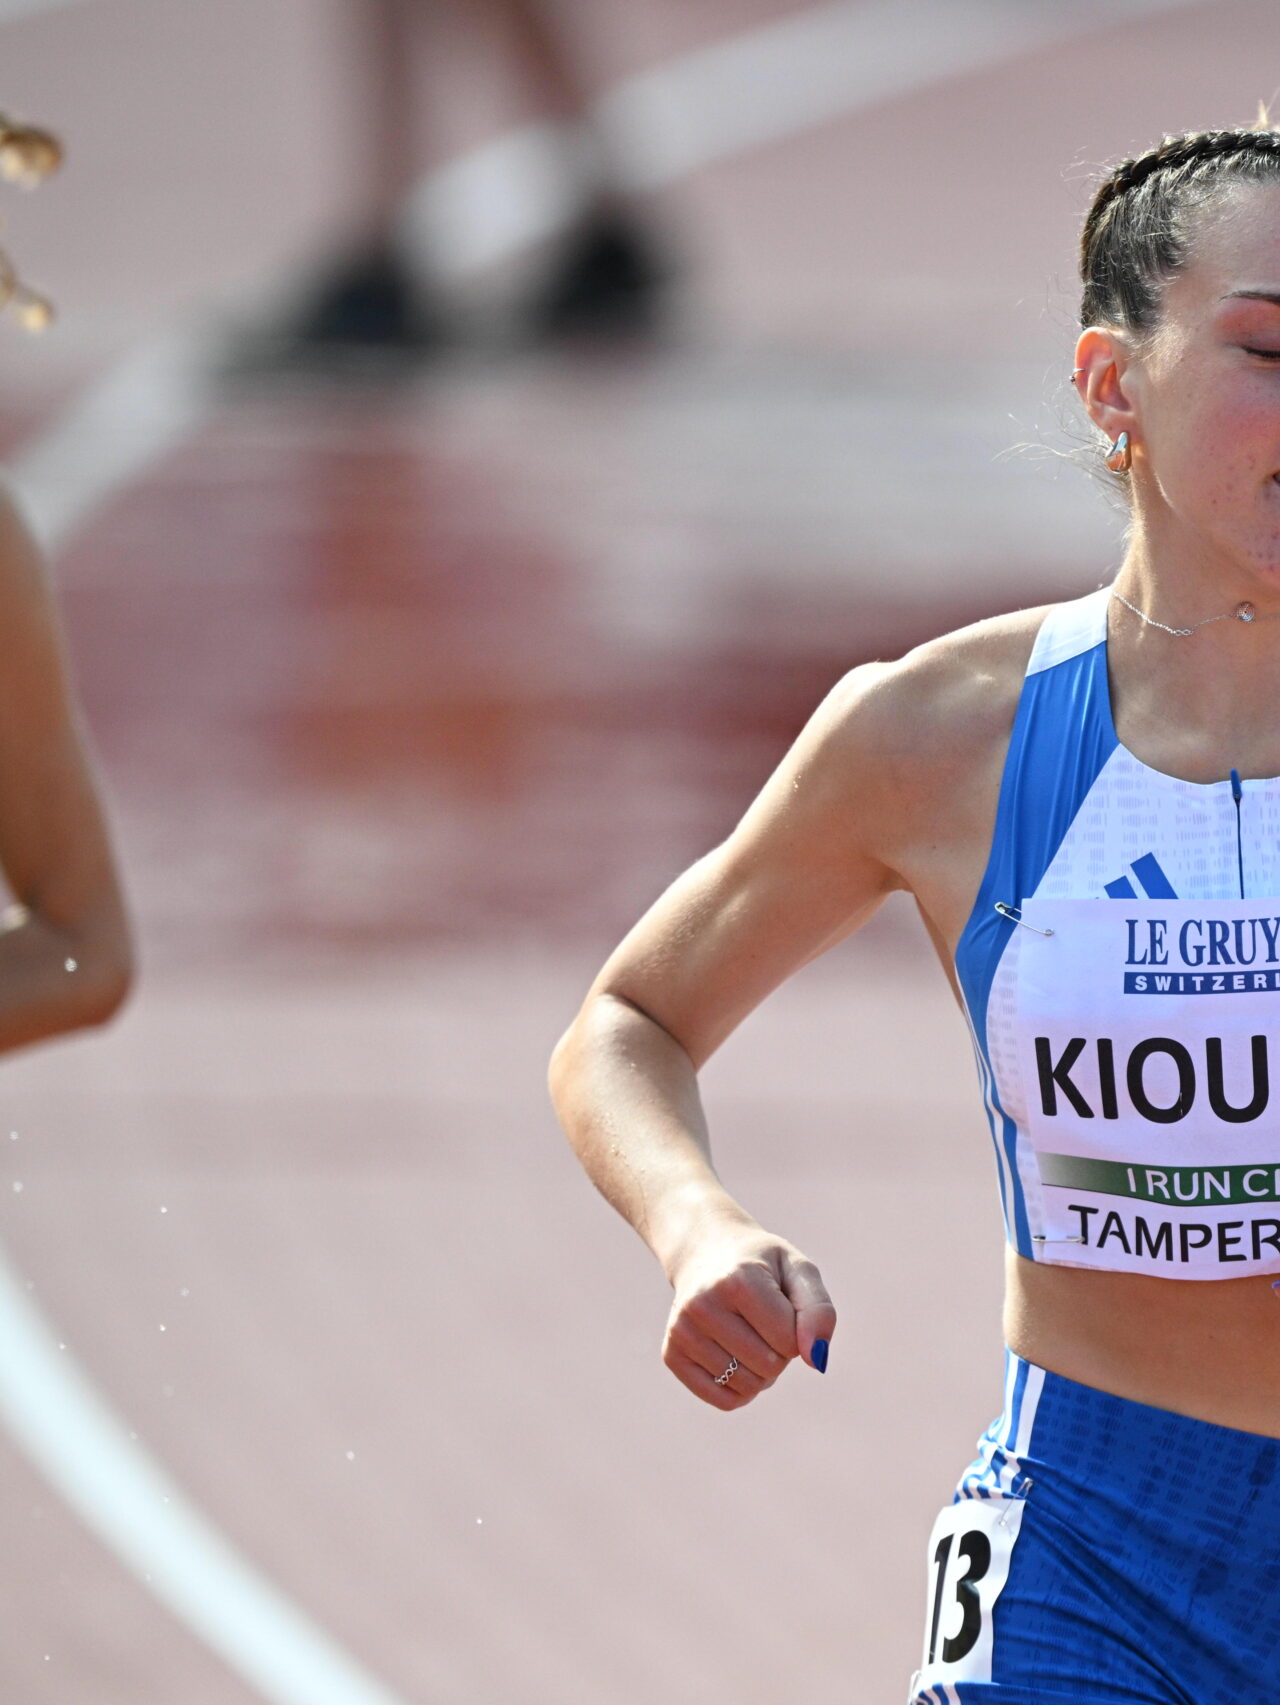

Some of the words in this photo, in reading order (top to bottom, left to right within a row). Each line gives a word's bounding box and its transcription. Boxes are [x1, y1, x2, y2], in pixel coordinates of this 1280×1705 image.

[1124, 918, 1169, 966] LE
[1127, 1168, 1137, 1193] I
[1147, 1169, 1231, 1201] RUN
[928, 1529, 991, 1665] 13
